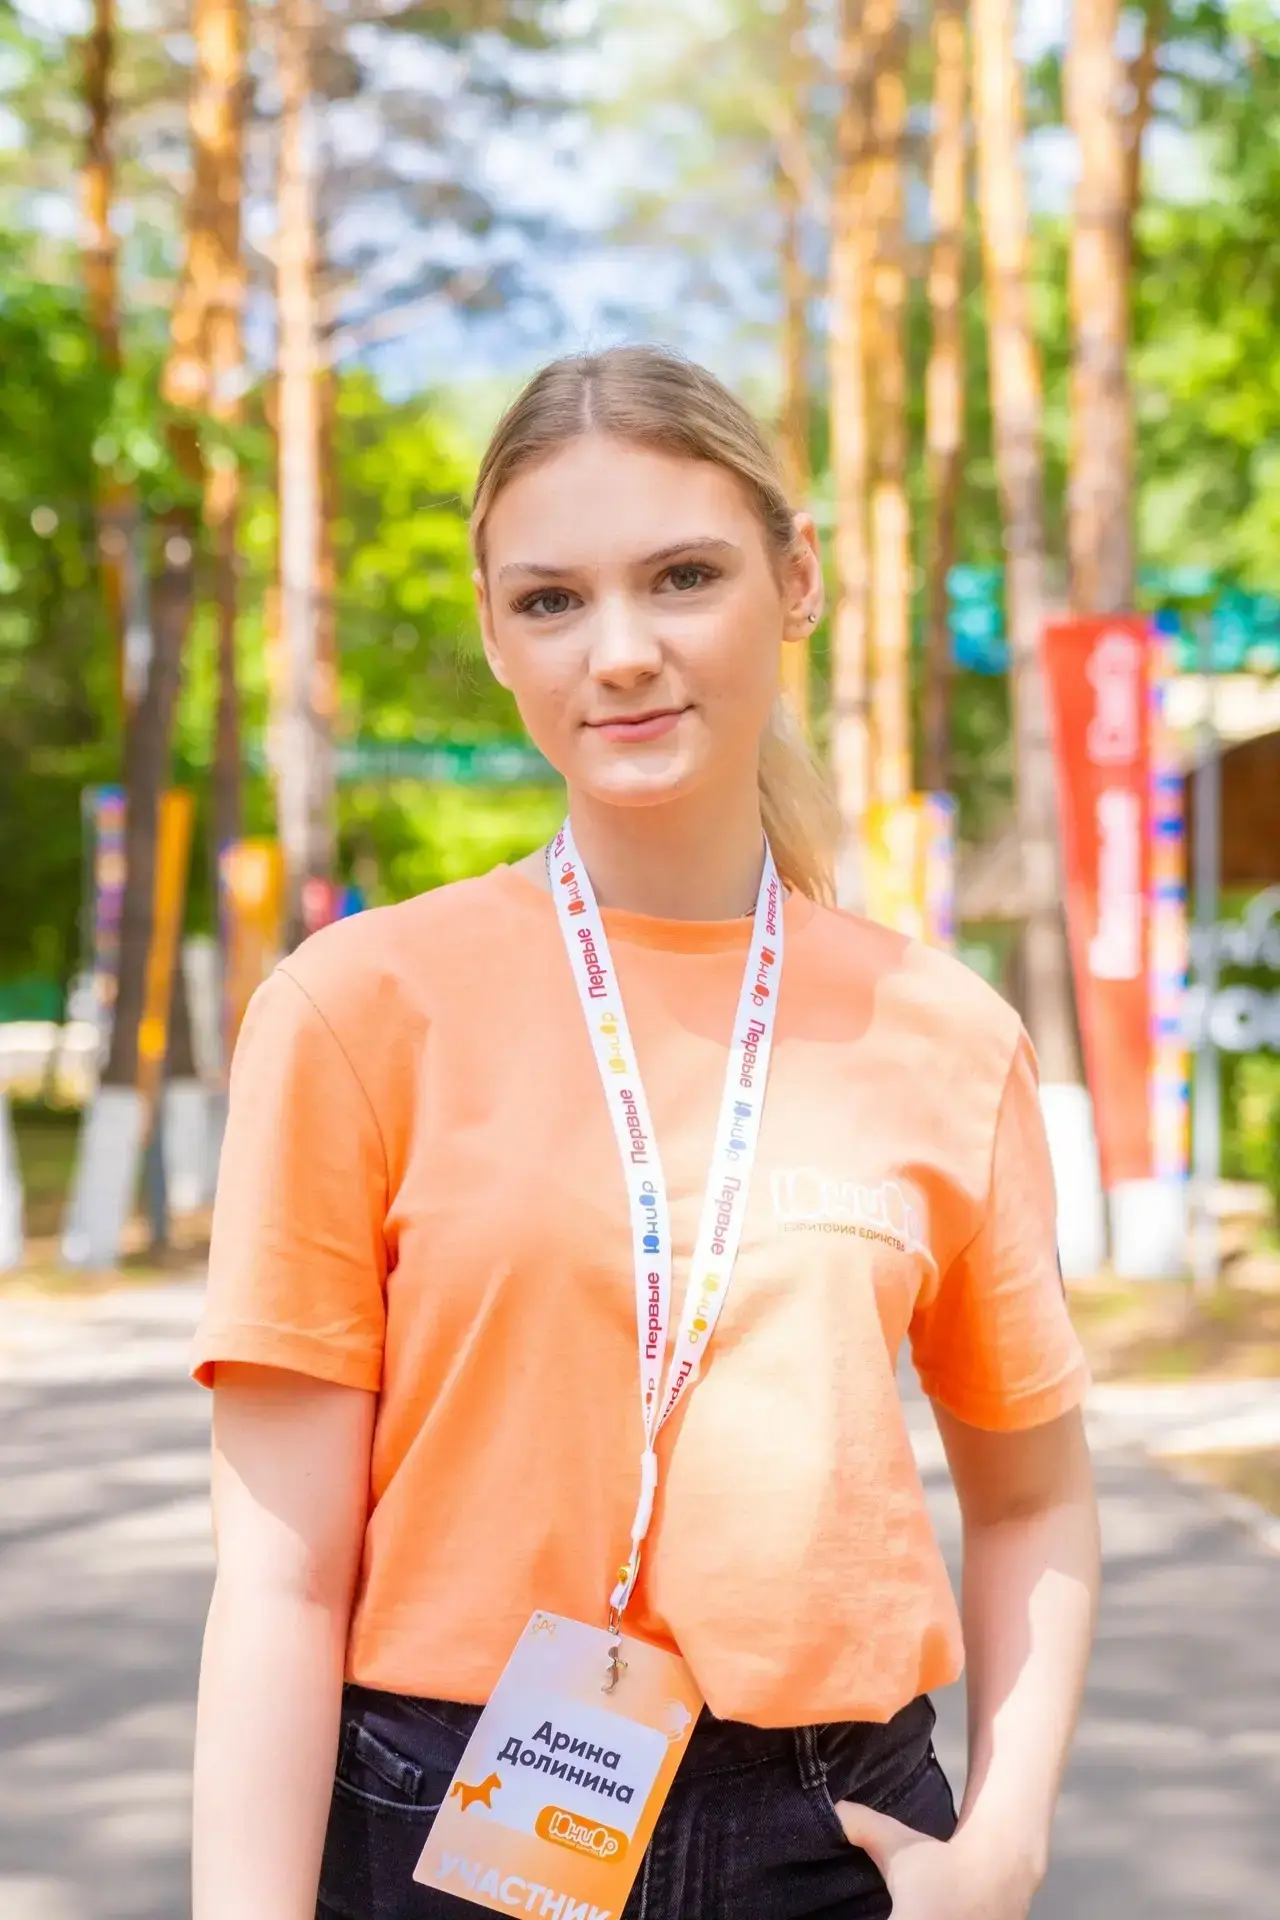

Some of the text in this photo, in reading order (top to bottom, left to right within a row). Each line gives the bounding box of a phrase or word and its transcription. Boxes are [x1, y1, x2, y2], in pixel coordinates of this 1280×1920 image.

[577, 928, 607, 998] Первые
[740, 1018, 766, 1088] Первые
[619, 1089, 648, 1164] Первые
[711, 1176, 741, 1256] Первые
[645, 1271, 662, 1360] Первые
[496, 1736, 635, 1804] Долинина
[531, 1720, 622, 1770] Арина
